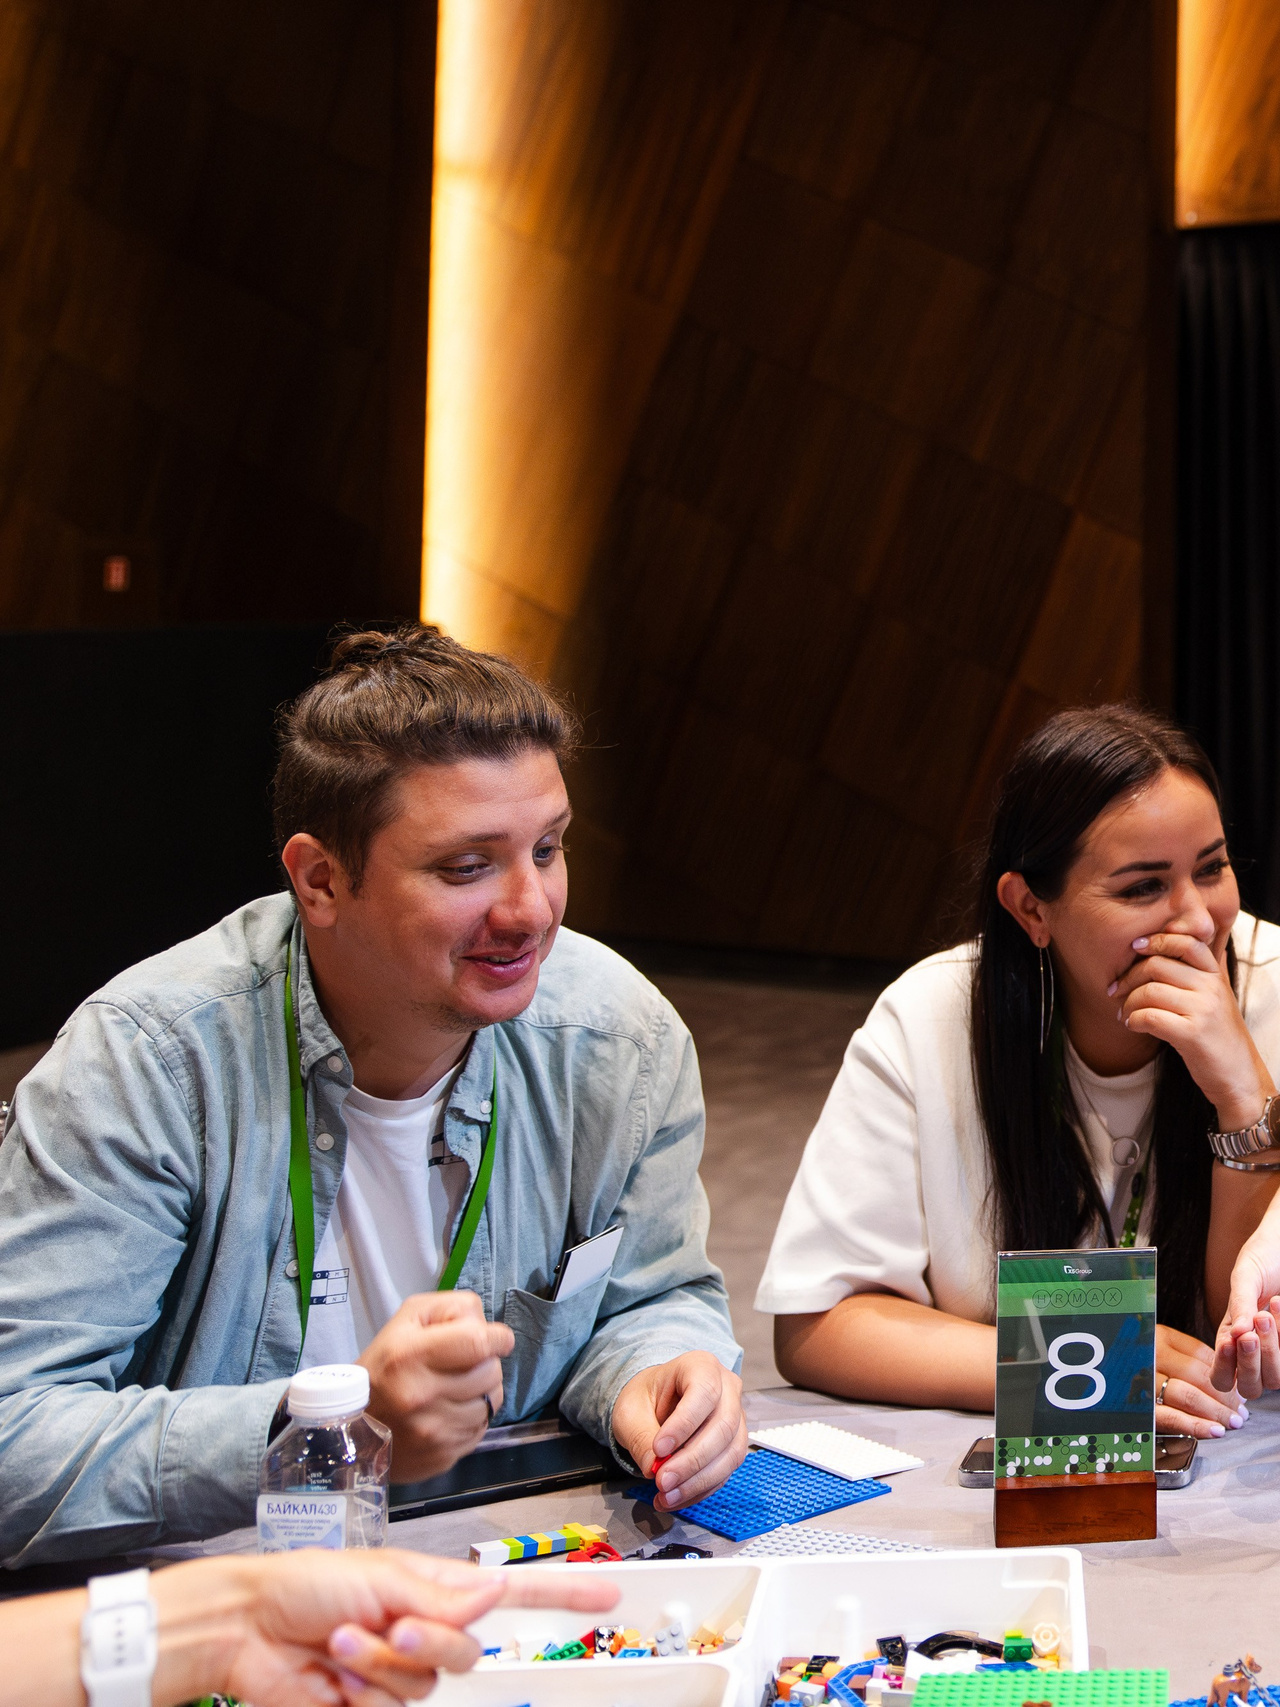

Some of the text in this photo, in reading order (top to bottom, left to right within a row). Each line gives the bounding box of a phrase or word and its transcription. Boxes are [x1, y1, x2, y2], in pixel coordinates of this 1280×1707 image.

[315, 1270, 348, 1279] OMMY
[312, 1295, 346, 1304] EANS
[1035, 1290, 1119, 1306] HRMAX
[1044, 1332, 1107, 1410] 8
